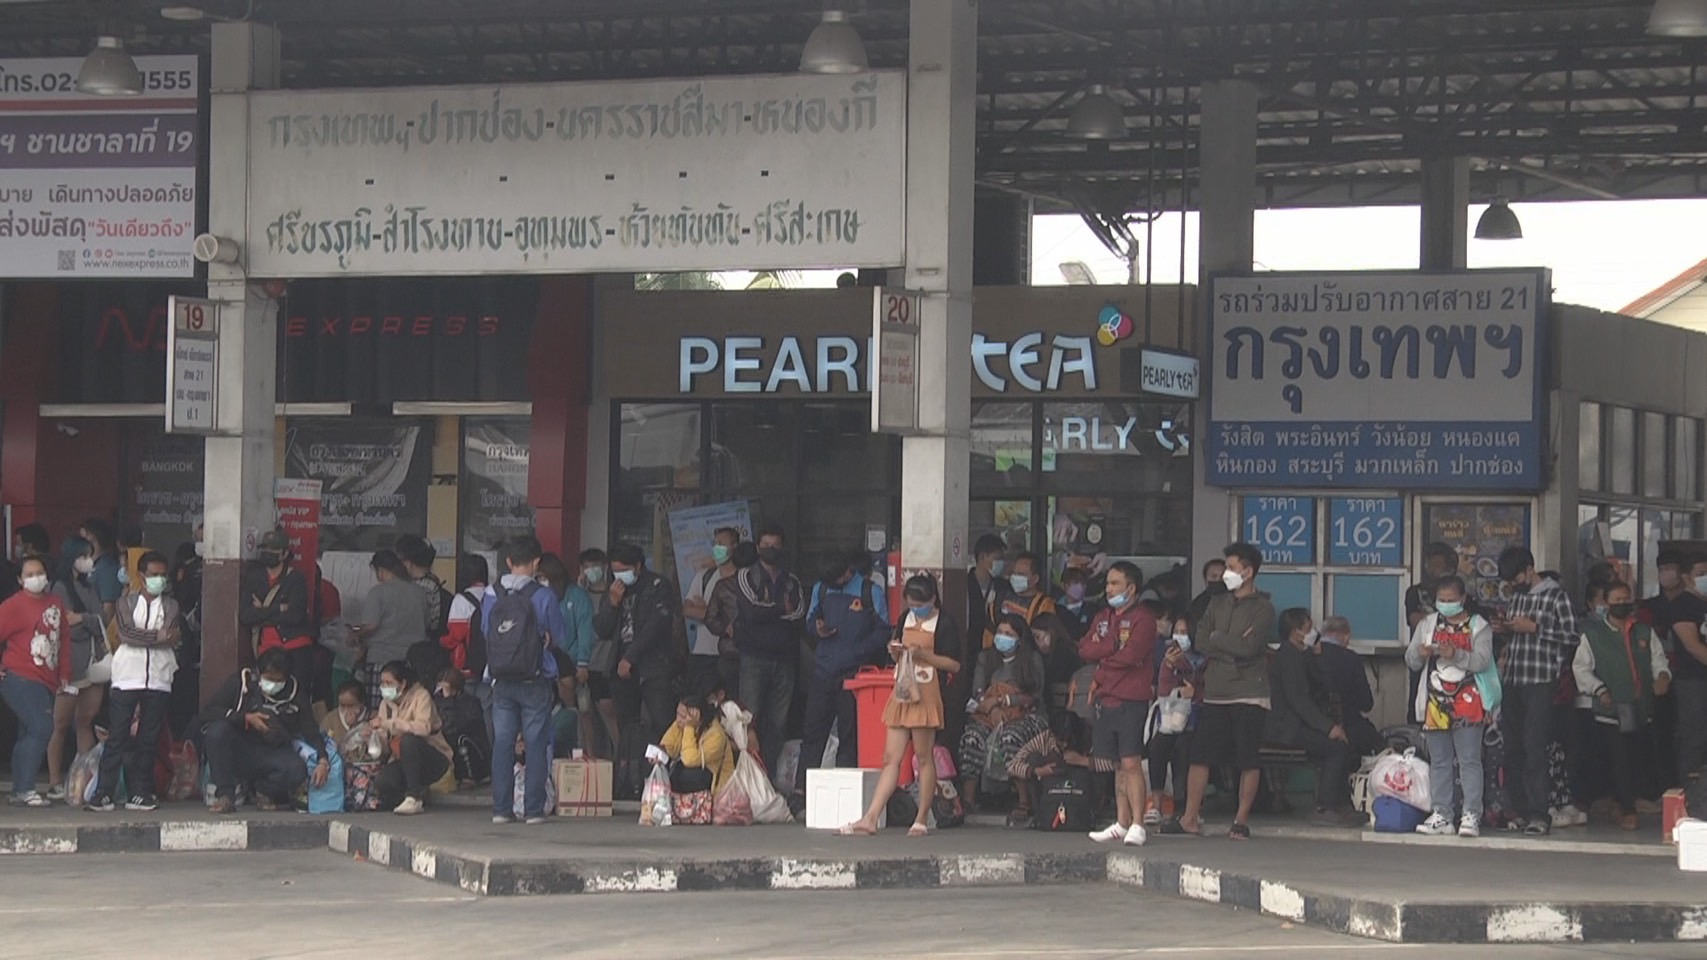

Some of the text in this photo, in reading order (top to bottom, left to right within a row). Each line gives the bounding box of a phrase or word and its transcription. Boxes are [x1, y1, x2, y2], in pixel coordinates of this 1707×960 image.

[27, 118, 159, 153] ชานชาลาที่
[166, 131, 193, 152] 19
[49, 182, 193, 203] เดินทางปลอดภัย
[84, 258, 189, 270] www.nexexpress.co.th
[887, 296, 909, 324] 20
[1219, 281, 1528, 314] รถร่วมปรับอากาศสาย 21
[184, 303, 204, 330] 19
[287, 316, 498, 336] EXPRESS
[679, 335, 873, 393] PEAR
[1143, 365, 1176, 388] PEARLY
[1223, 324, 1523, 414] กรุงเทพฯ
[1221, 423, 1520, 447] รังสิต พระอินทร์ วังน้อย หนองแค
[142, 460, 194, 473] BANGKOK
[1216, 447, 1523, 482] หินกอง สระบุรี มวกเหล็ก ปากช่อง
[1258, 497, 1297, 511] ราคา
[1346, 498, 1385, 512] ราคา
[1247, 515, 1306, 547] 162
[1335, 516, 1396, 548] 162
[1349, 550, 1381, 565] บาท
